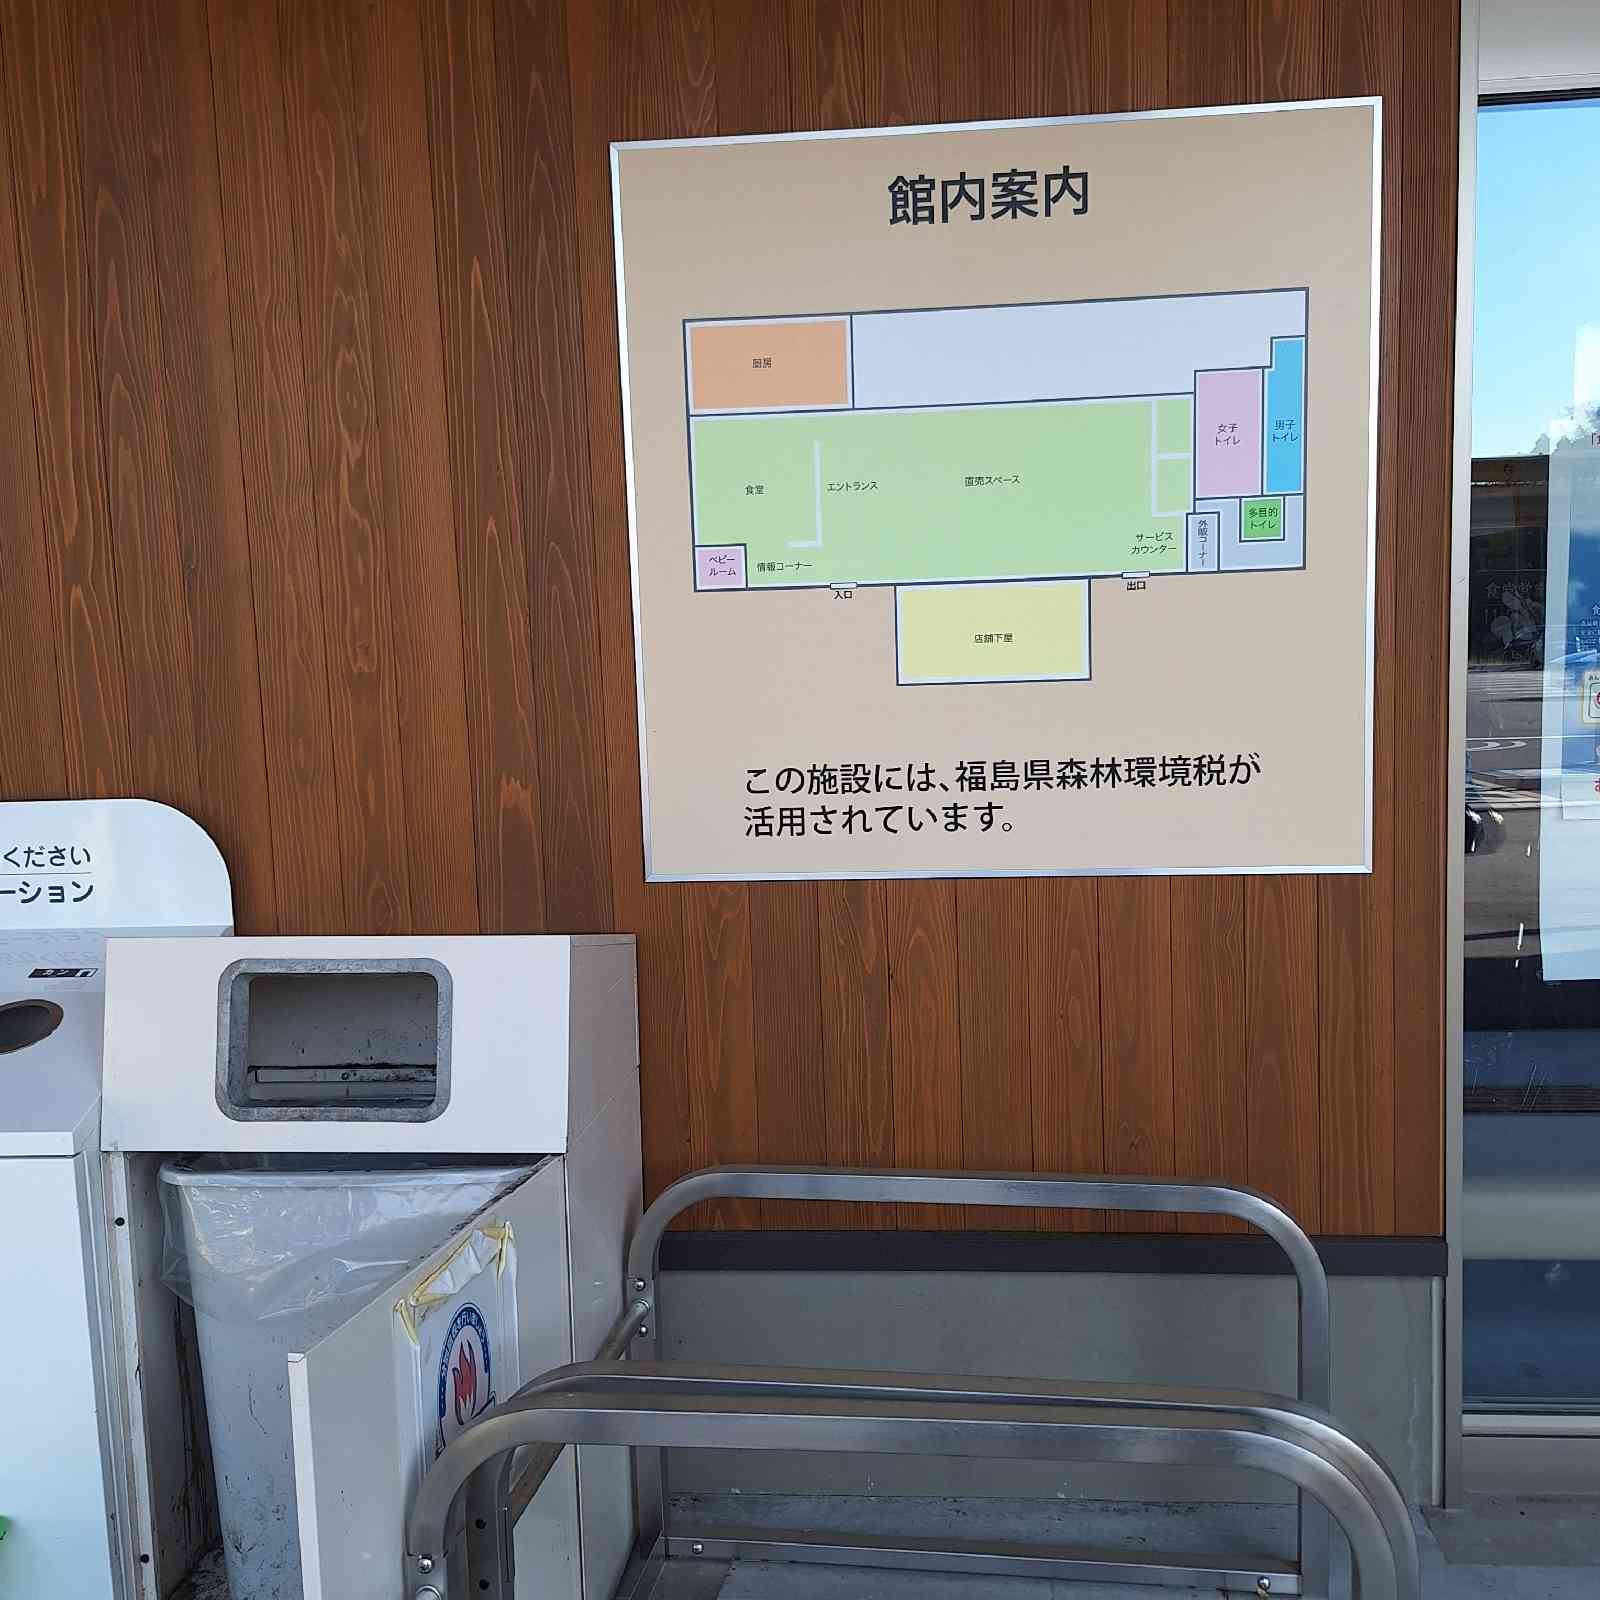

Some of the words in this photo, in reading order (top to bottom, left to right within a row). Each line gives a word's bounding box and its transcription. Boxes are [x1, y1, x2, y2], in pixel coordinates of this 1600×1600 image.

[887, 164, 1089, 226] 館内案内
[1217, 423, 1239, 434] 女子
[1274, 419, 1296, 431] 男子
[1215, 435, 1241, 447] トイレ
[1272, 431, 1299, 443] トイレ
[827, 481, 878, 492] エントランス
[964, 474, 1021, 487] 直売スペース
[744, 484, 765, 496] 食堂
[1248, 506, 1278, 519] 多目的
[1250, 519, 1276, 529] トイレ
[1135, 531, 1174, 543] サービス
[1131, 544, 1177, 555] カウンター
[709, 567, 737, 577] ルーム
[756, 561, 813, 573] 情報コーナー
[1126, 580, 1146, 591] 出口
[834, 590, 853, 600] 入口
[974, 632, 1013, 644] 店舗下屋
[746, 752, 1262, 796] この施設には、福島県森林環境税が
[743, 801, 1013, 838] 活用されています。
[3, 845, 91, 869] ください
[0, 880, 94, 904] ーション
